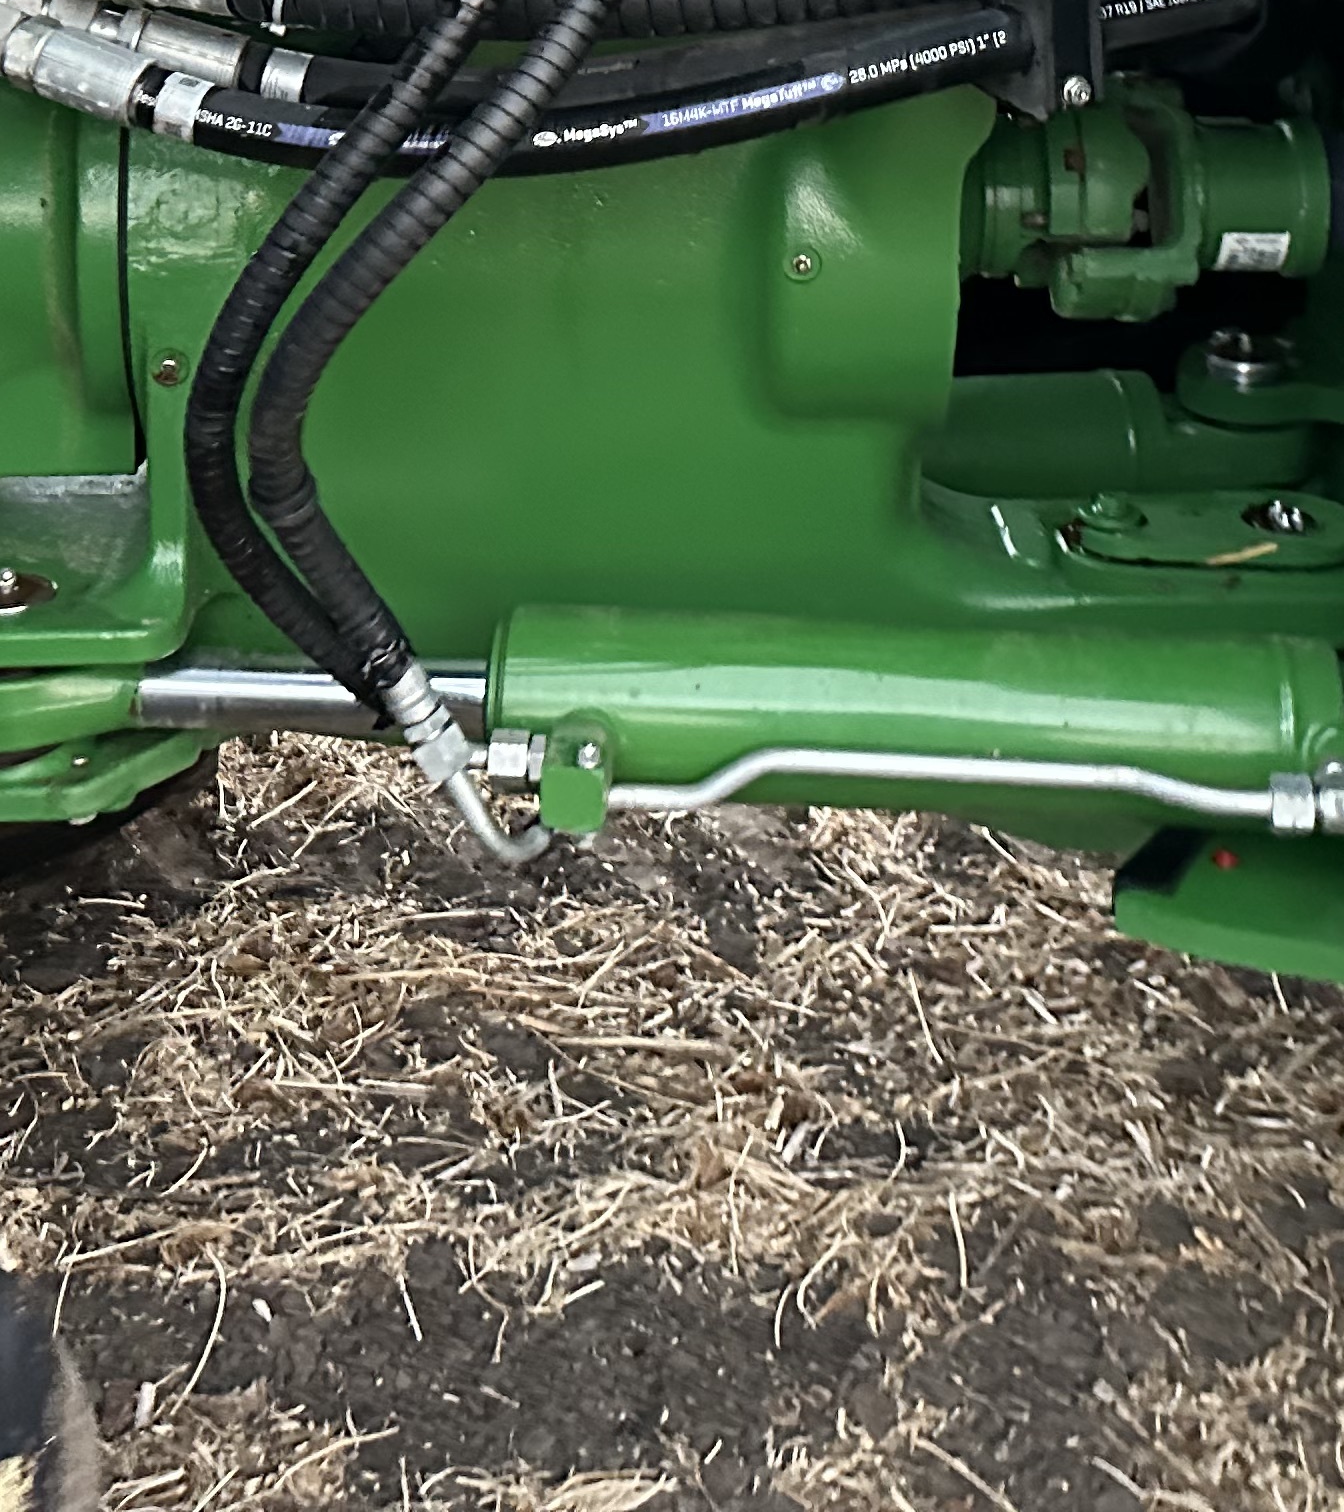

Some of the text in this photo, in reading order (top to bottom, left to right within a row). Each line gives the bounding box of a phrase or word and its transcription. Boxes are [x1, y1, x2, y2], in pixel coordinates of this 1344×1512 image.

[849, 64, 879, 84] 28.0
[909, 45, 948, 71] (4000
[948, 37, 976, 56] PSI)
